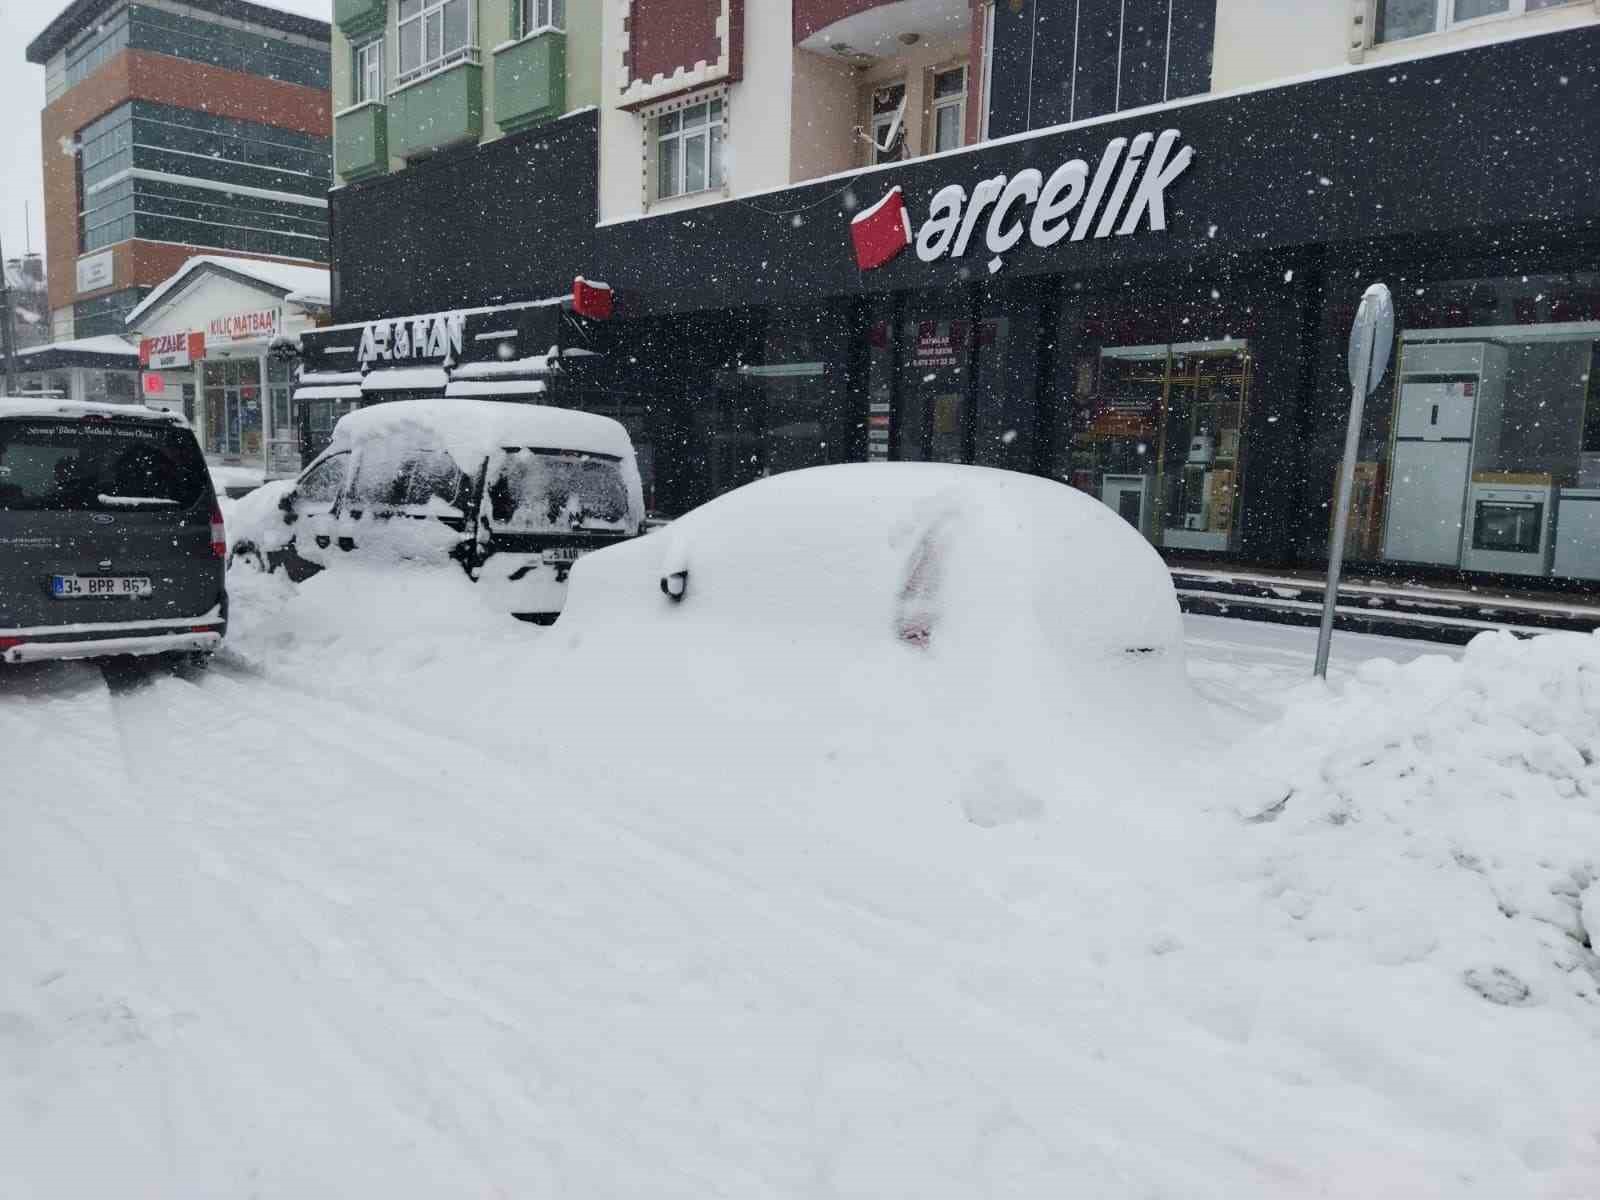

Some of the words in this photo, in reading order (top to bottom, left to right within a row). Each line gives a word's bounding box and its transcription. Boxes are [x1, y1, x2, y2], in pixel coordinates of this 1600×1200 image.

[916, 129, 1196, 274] arçelik
[233, 311, 273, 333] MATBAA
[64, 580, 81, 594] 34
[88, 579, 114, 593] BPR
